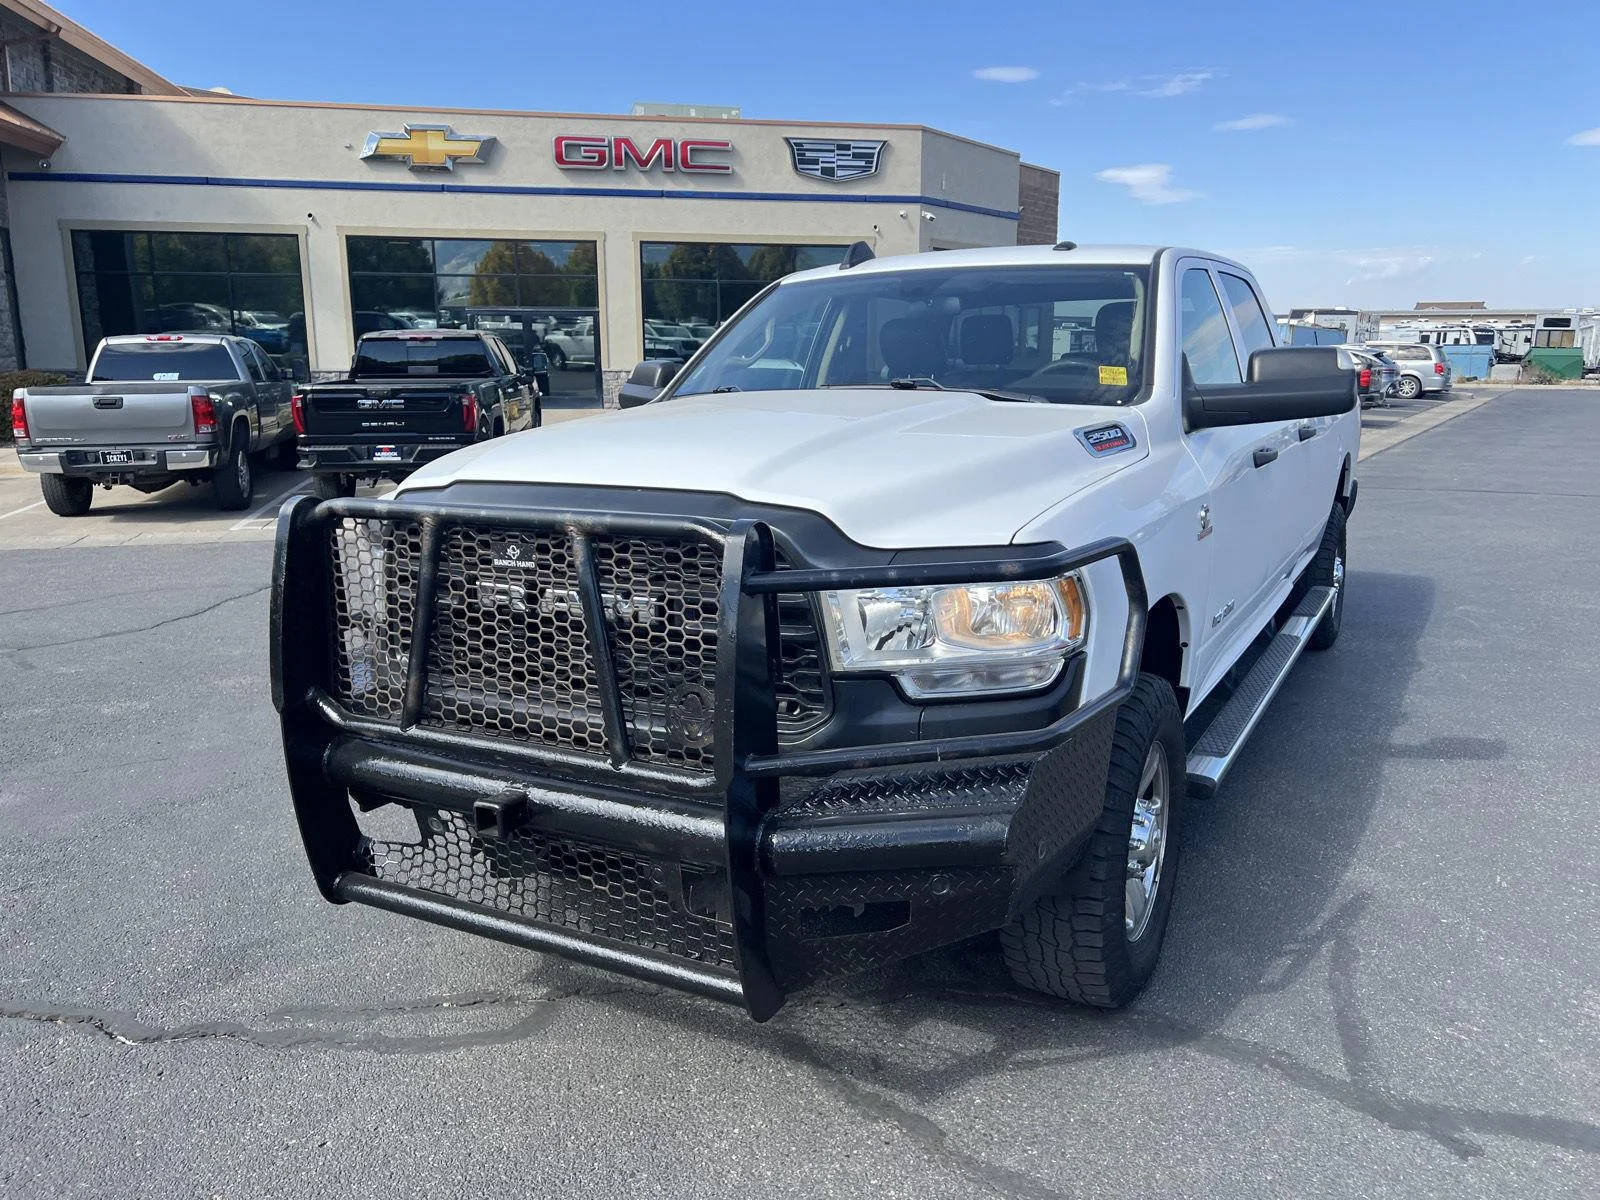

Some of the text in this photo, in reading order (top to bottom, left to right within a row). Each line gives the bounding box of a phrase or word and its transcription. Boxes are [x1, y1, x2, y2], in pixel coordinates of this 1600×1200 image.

[552, 136, 734, 174] GMC
[357, 399, 405, 409] GMC
[1087, 428, 1122, 444] 2500
[494, 558, 535, 568] RANCH HAND
